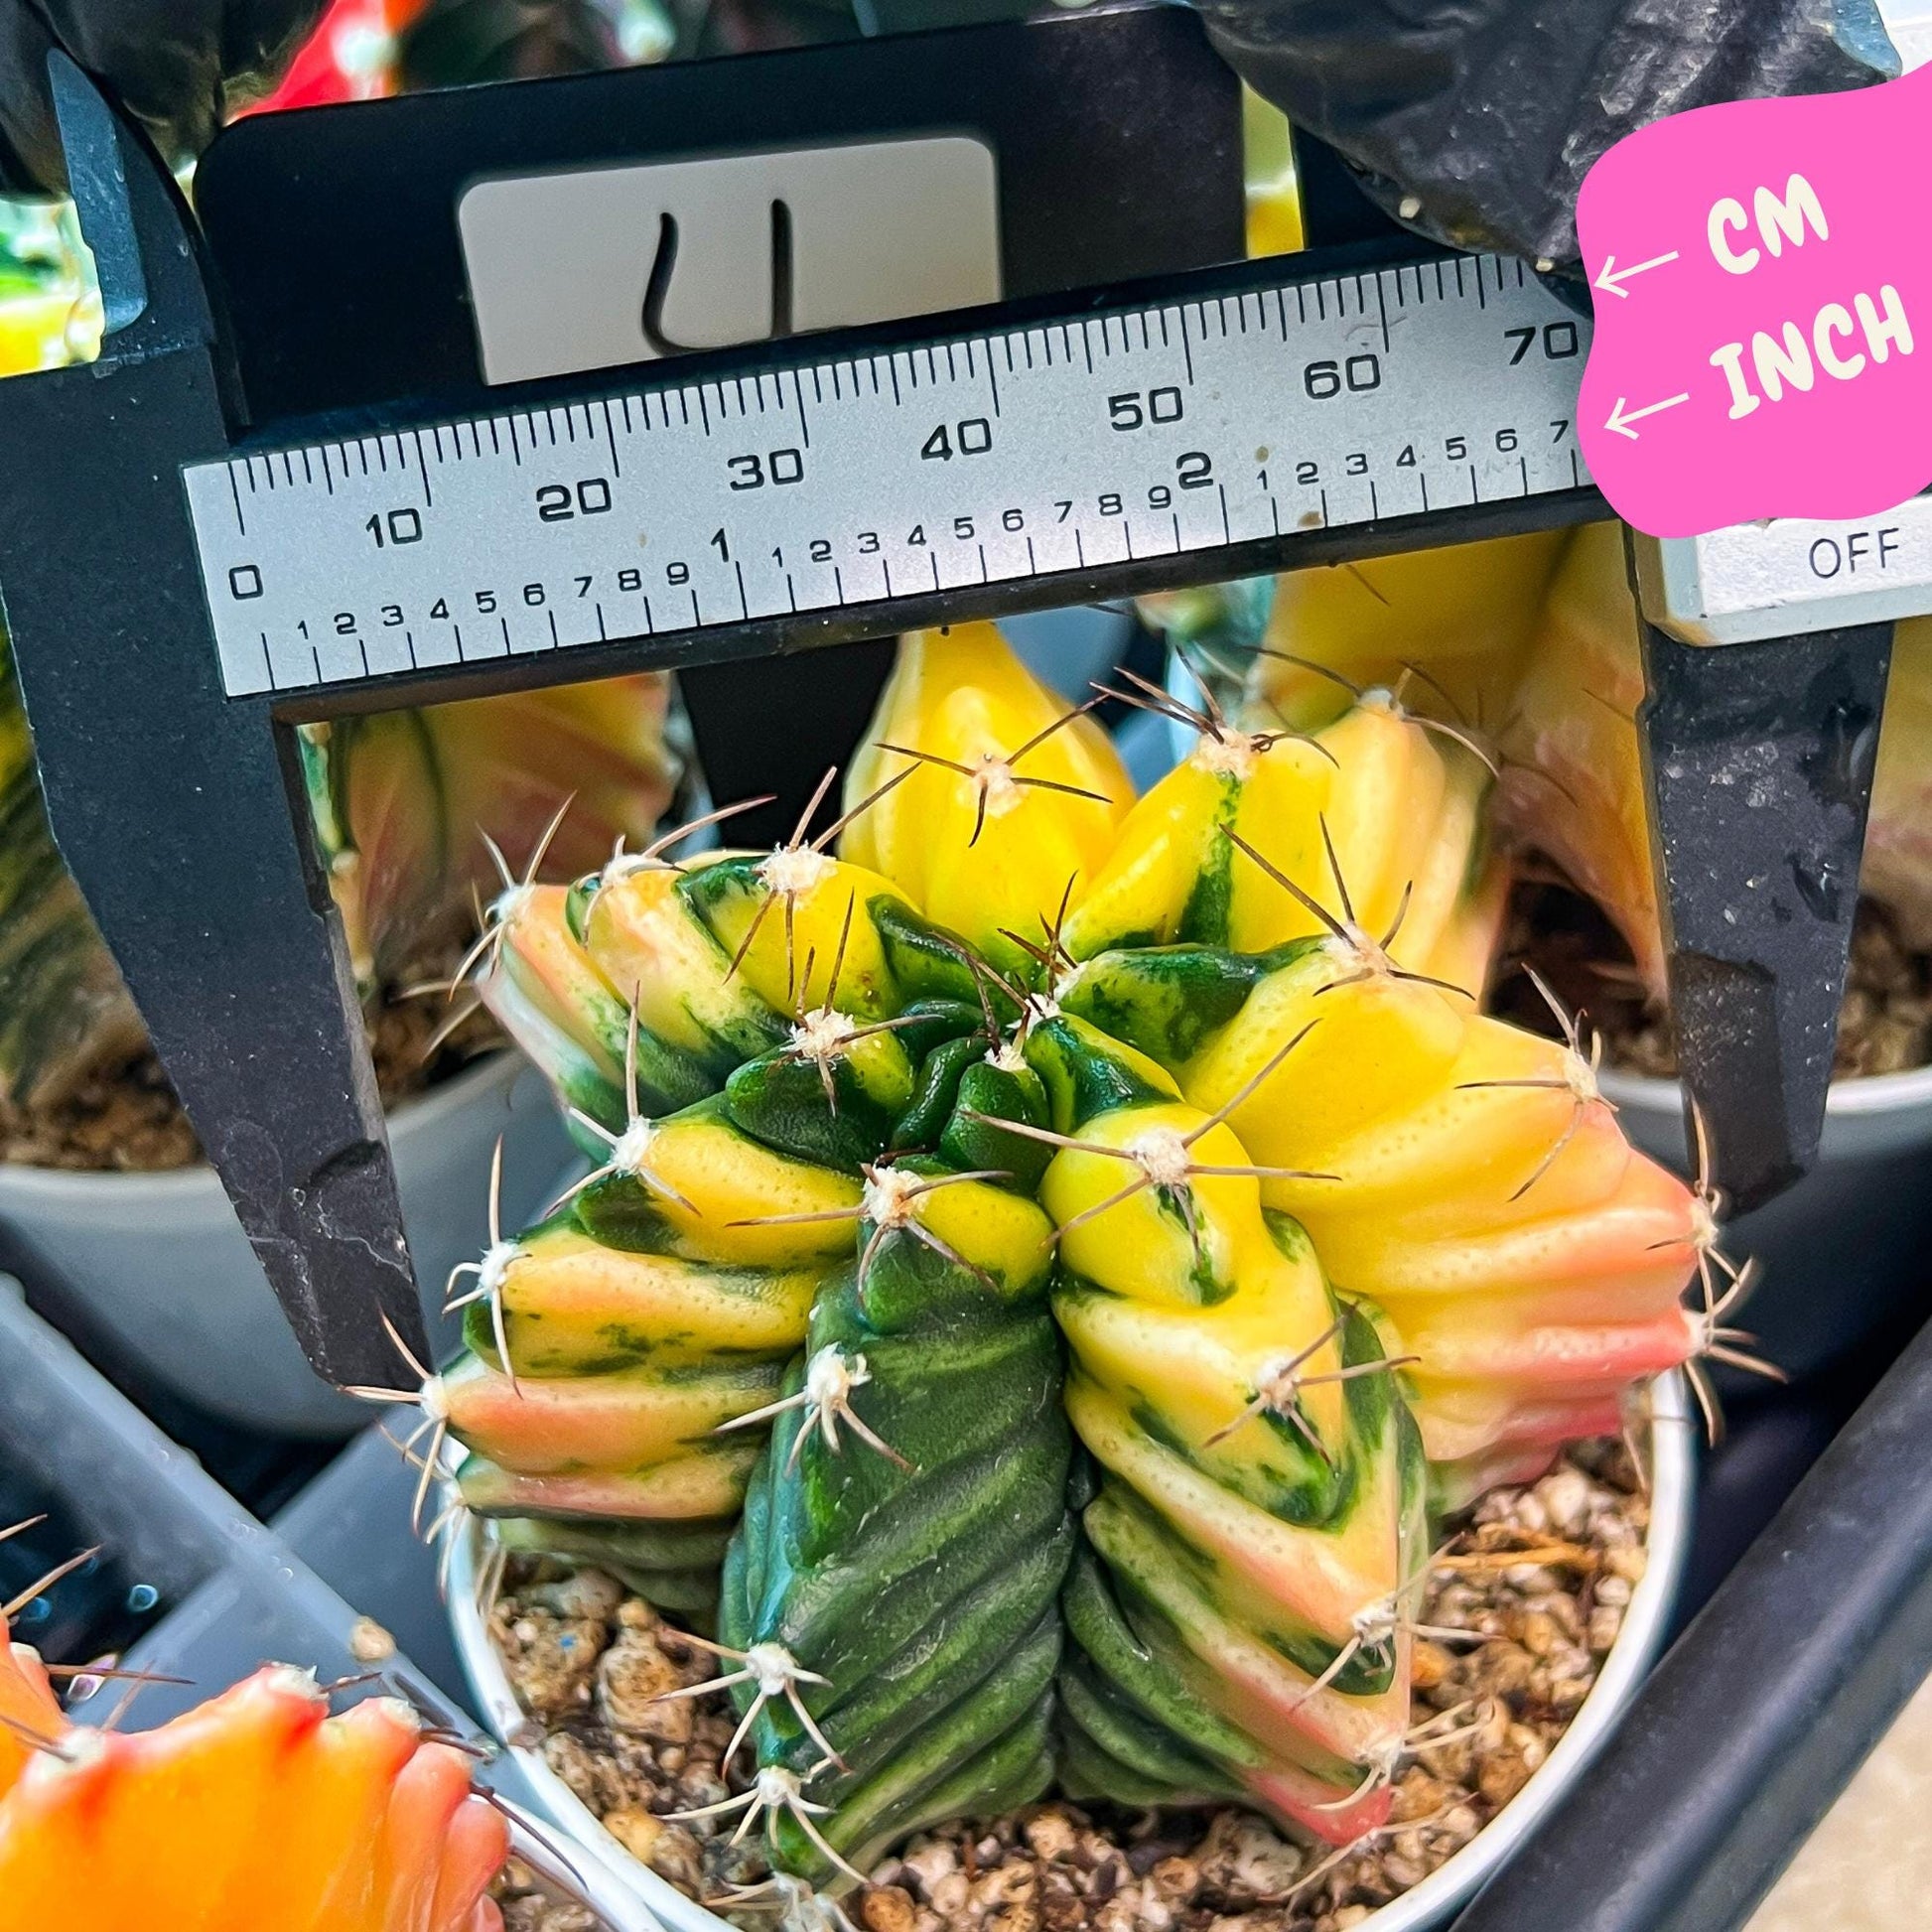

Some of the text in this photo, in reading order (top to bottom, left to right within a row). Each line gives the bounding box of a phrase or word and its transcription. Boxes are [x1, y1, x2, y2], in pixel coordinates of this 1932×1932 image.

[228, 321, 1580, 600] 0 10 20 30 40 50 60 70
[298, 420, 1569, 639] 1 2 3 4 5 6 7 8 9 1 1 2 3 4 5 6 7 8 9 2 1 2 3 4 5 6 7
[1809, 528, 1899, 579] OFF
